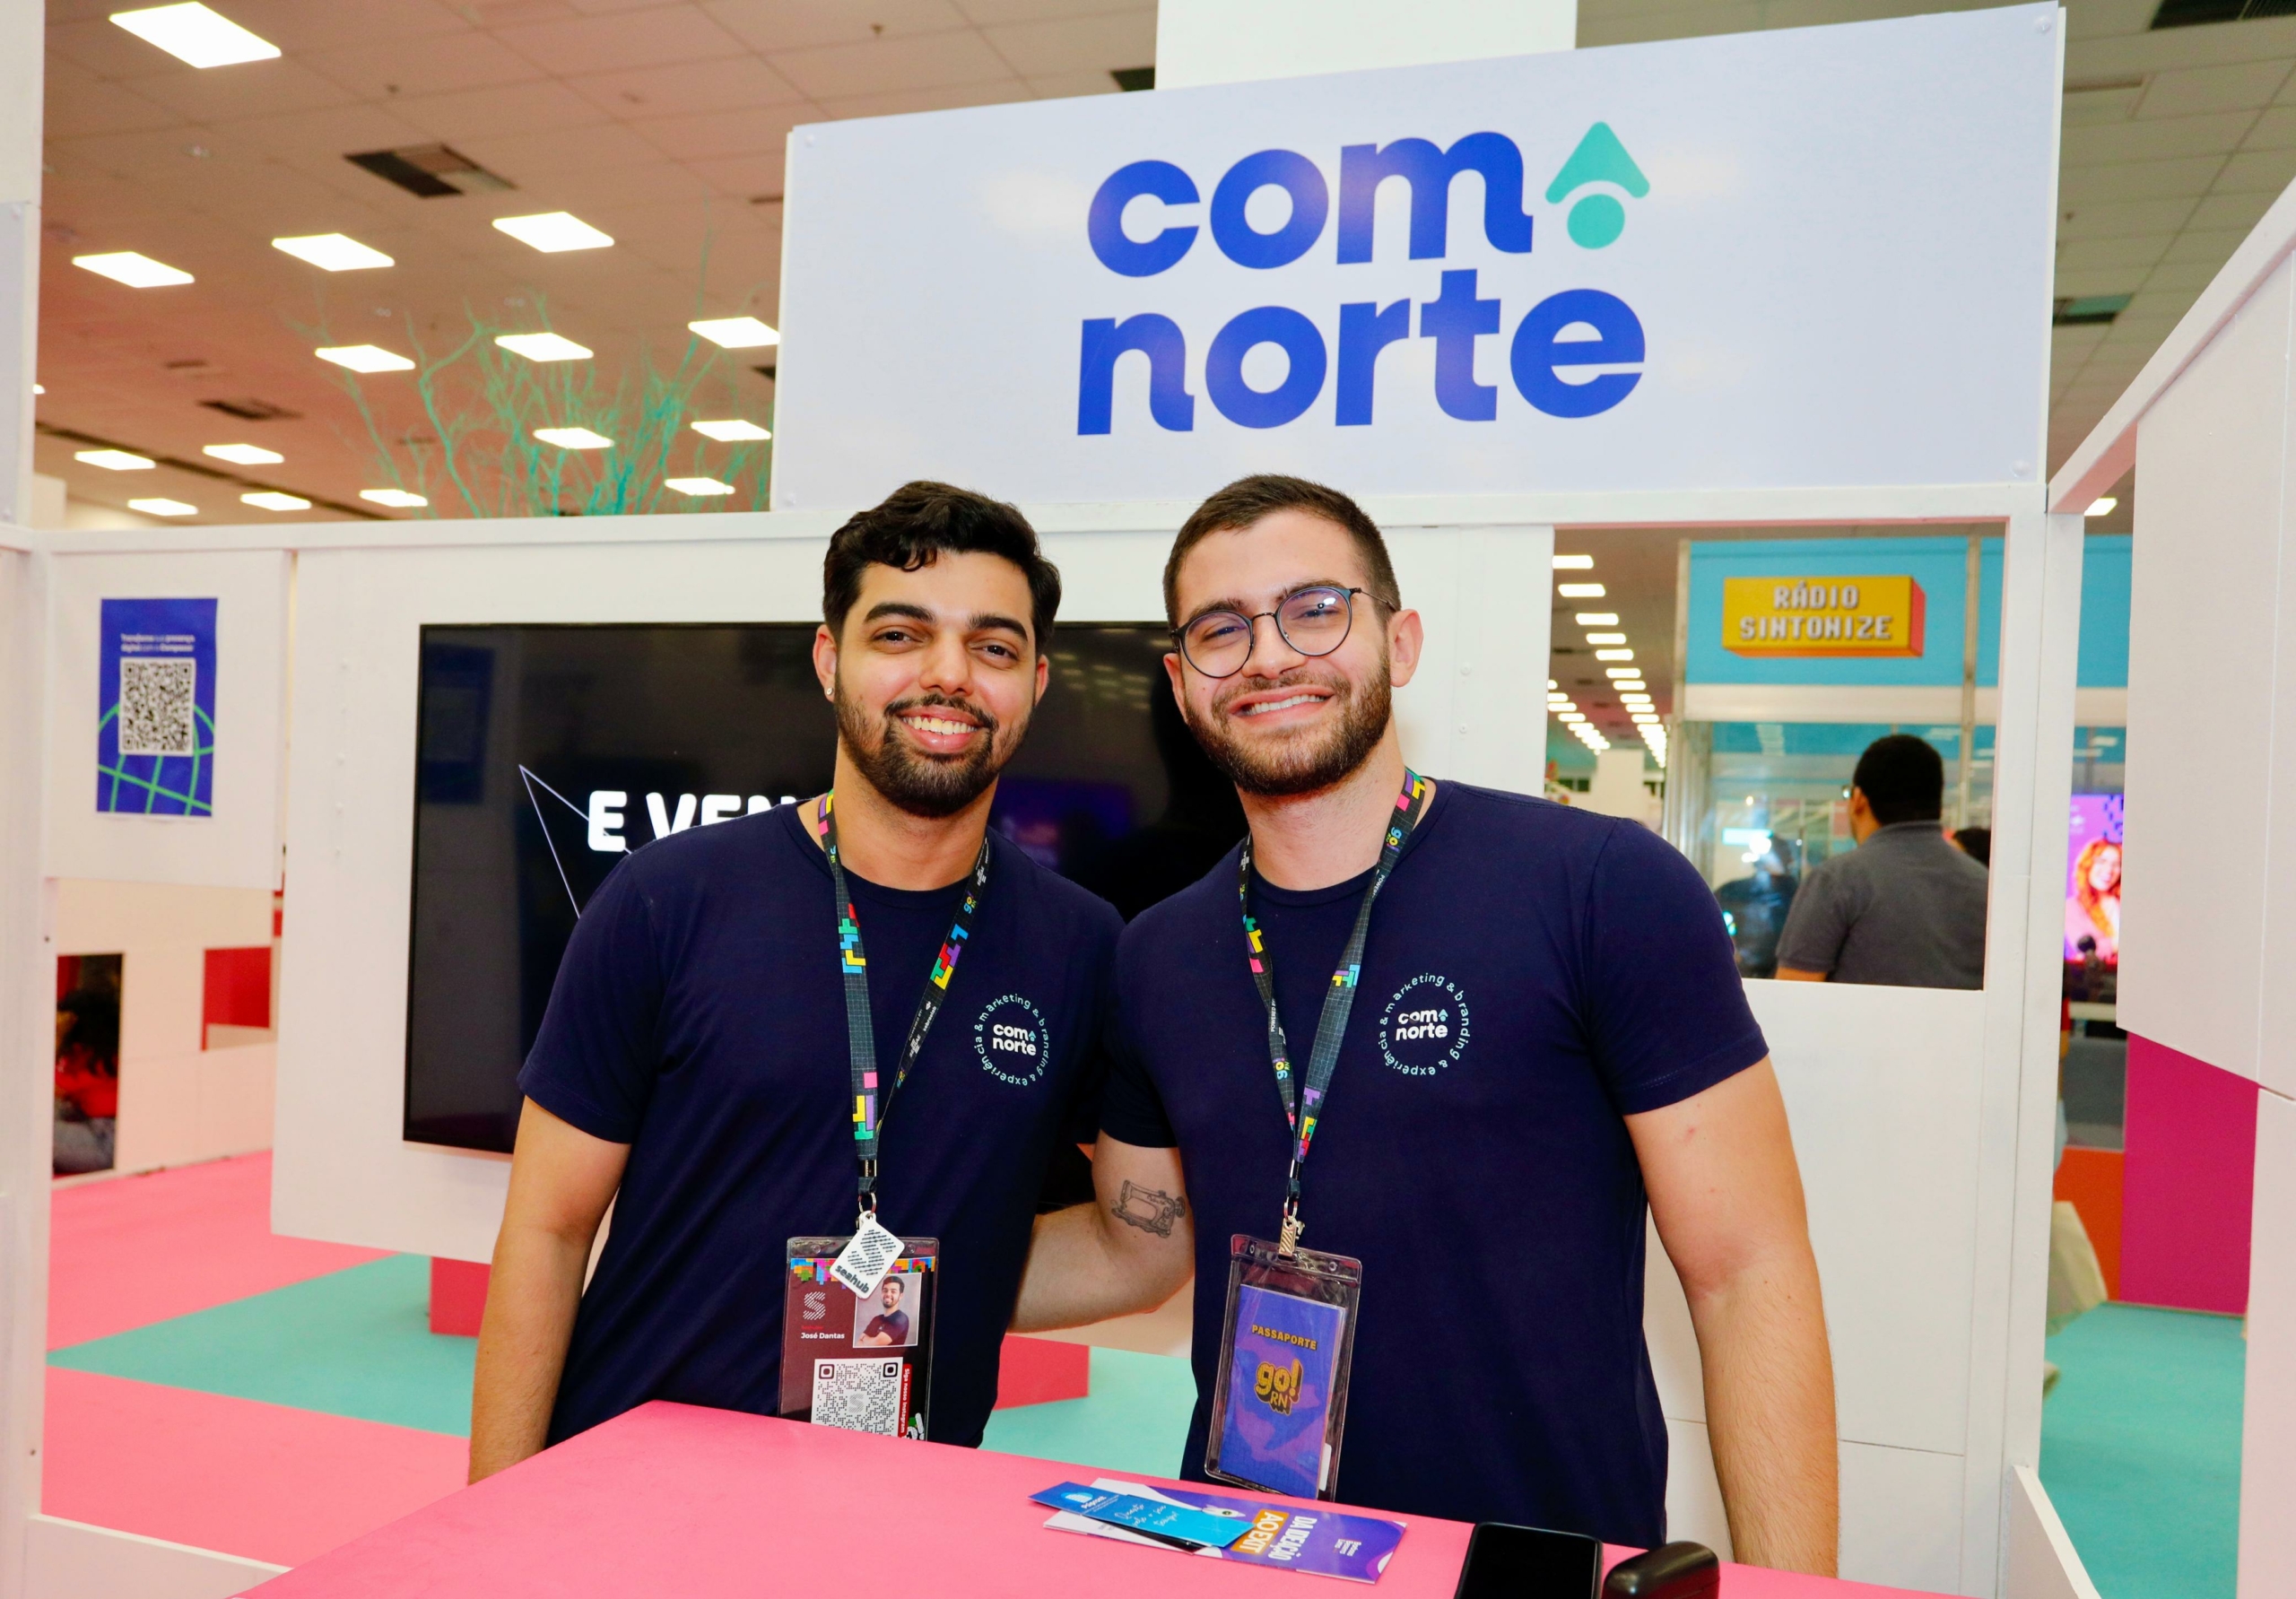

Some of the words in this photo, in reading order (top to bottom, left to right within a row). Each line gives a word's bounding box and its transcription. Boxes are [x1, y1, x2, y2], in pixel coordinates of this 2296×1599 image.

[1088, 131, 1533, 277] com
[1077, 269, 1645, 435] norte
[1774, 579, 1859, 609] RÁDIO
[1740, 615, 1892, 639] SINTONIZE
[587, 790, 627, 852] E
[978, 994, 1031, 1021] marketing
[1385, 973, 1445, 1012] marketing
[1396, 1022, 1448, 1040] norte
[1398, 1009, 1438, 1024] com
[1449, 990, 1470, 1060] branding
[993, 1024, 1029, 1041] com
[993, 1038, 1036, 1056] norte
[1036, 1018, 1049, 1076] branding
[974, 1036, 1028, 1086] experiência
[1378, 1031, 1436, 1075] experiência
[834, 1264, 870, 1294] seahub
[1251, 1325, 1318, 1350] PASSAPORTE
[1255, 1359, 1300, 1398] go!
[1270, 1391, 1288, 1409] RN
[1257, 1511, 1283, 1531] AO
[1290, 1516, 1318, 1529] DA
[1239, 1530, 1274, 1553] EXIT
[1267, 1528, 1309, 1560] IDEAÇÃO
